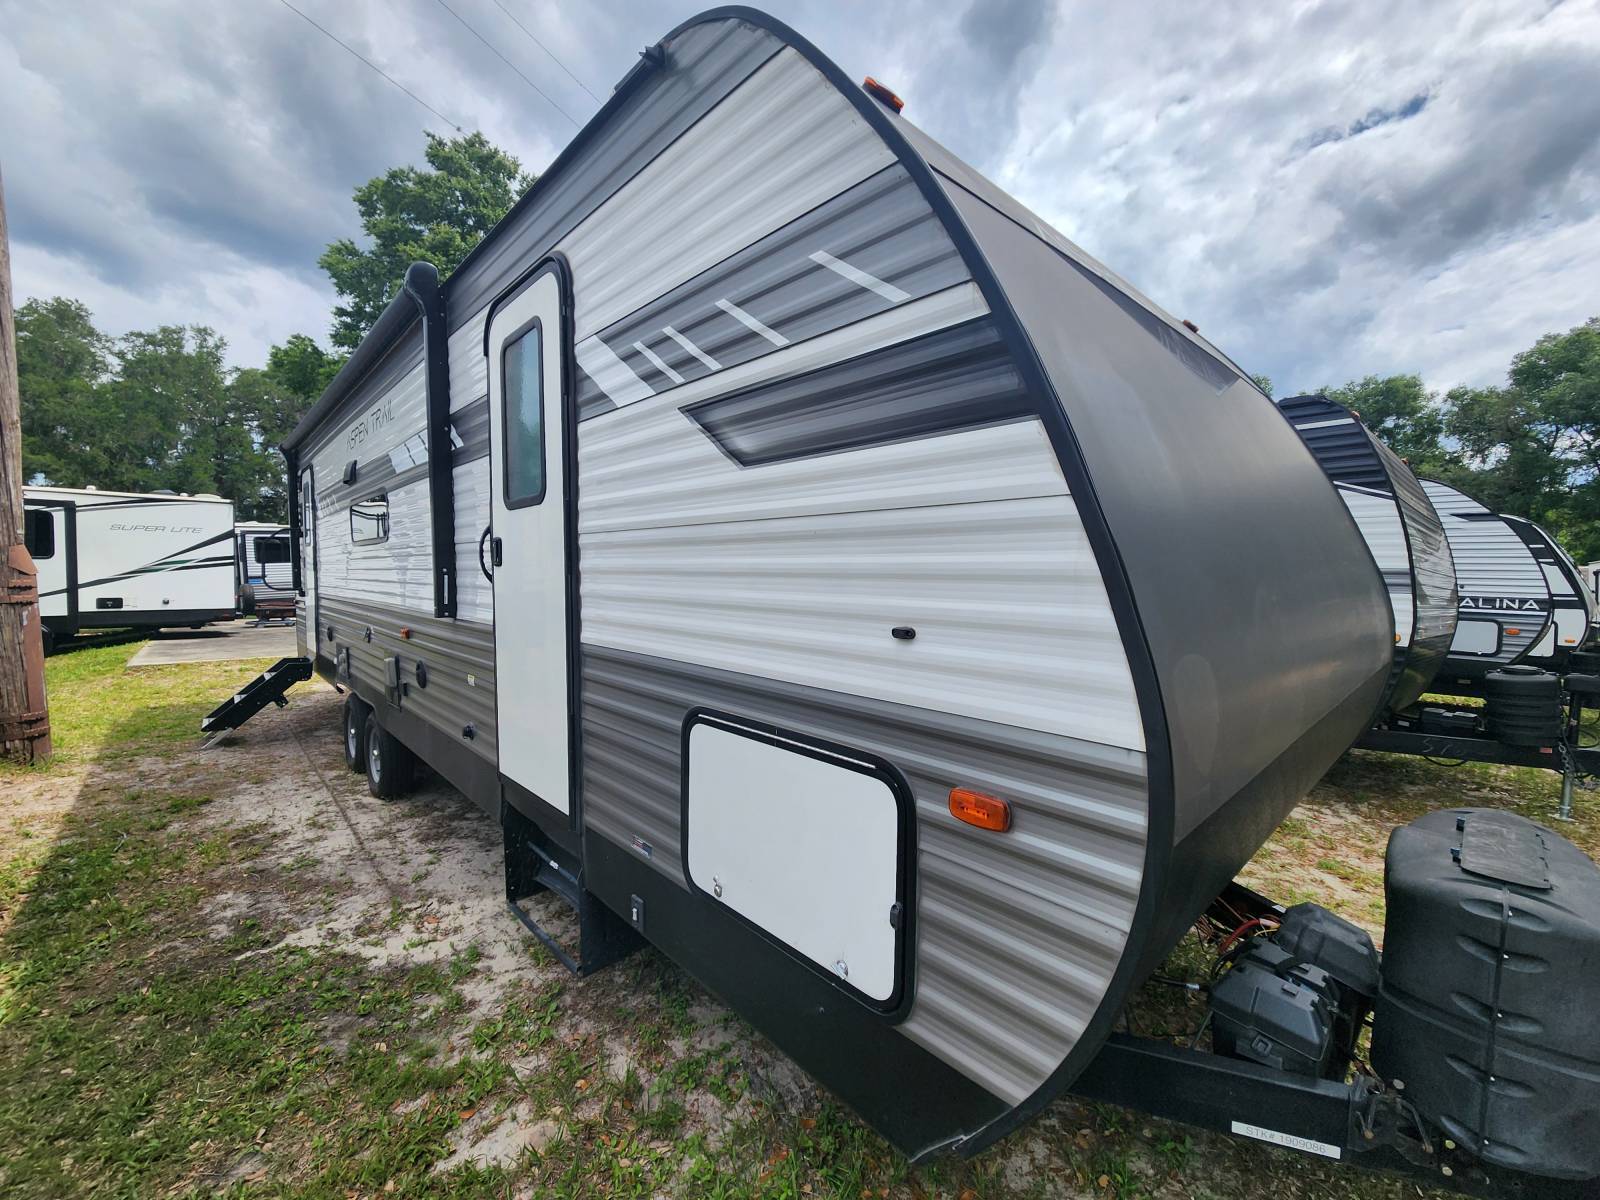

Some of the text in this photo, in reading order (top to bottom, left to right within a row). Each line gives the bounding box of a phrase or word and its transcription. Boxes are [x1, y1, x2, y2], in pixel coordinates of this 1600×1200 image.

[371, 400, 395, 432] TRAIL
[109, 523, 203, 534] SUPER LITE
[1459, 597, 1540, 610] ALINA
[1246, 1126, 1326, 1154] STK# 1909086
